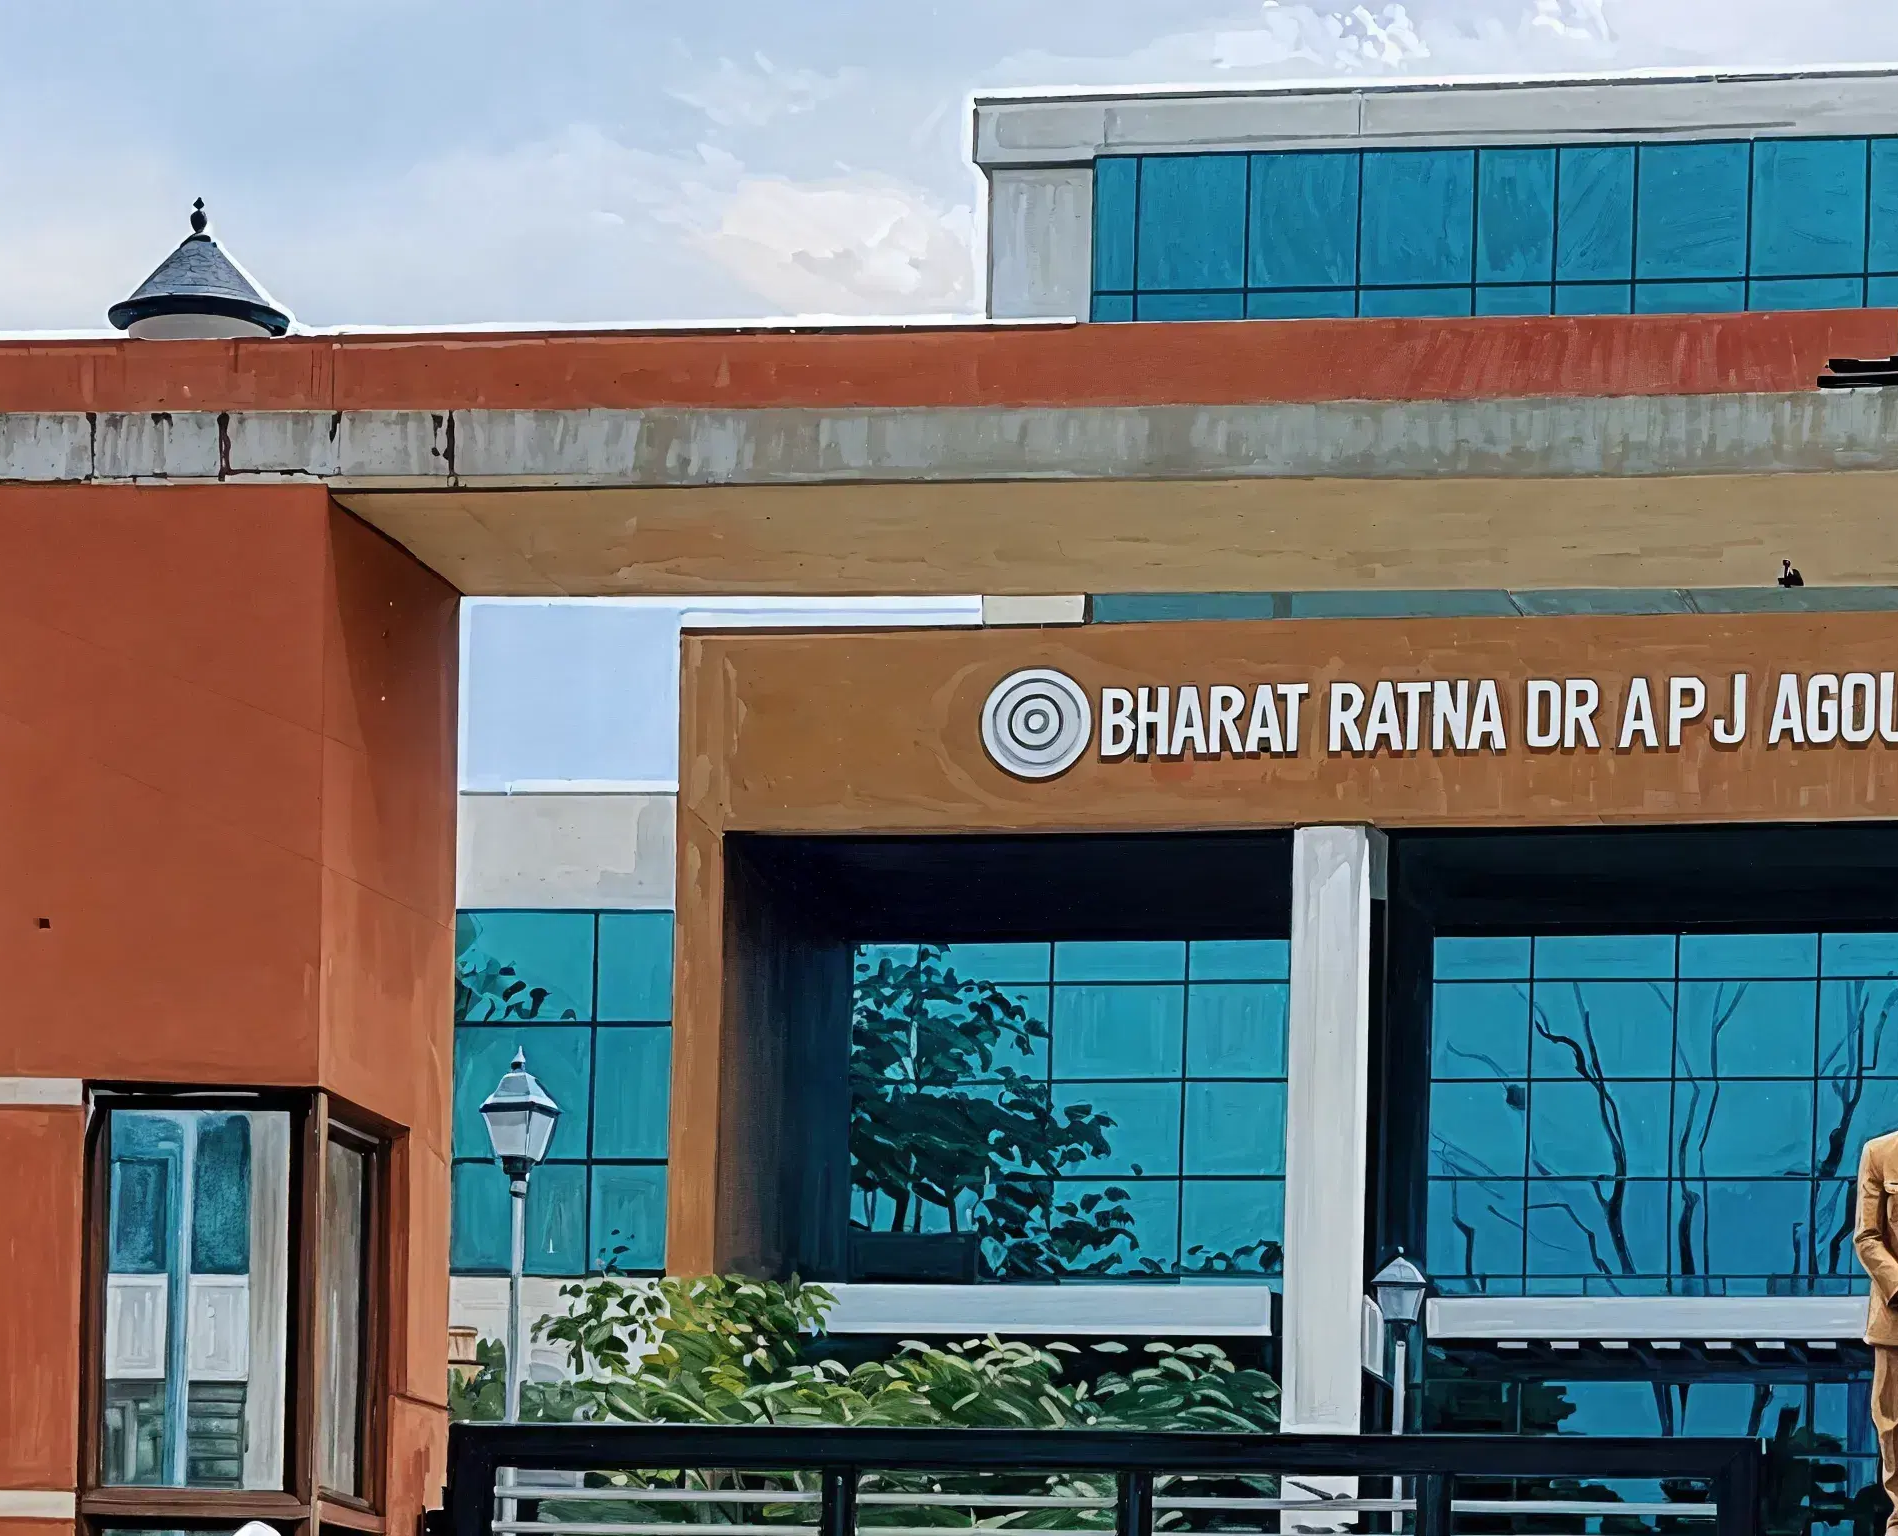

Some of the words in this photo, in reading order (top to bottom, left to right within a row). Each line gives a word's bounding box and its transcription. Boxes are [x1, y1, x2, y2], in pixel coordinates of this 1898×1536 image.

[1100, 682, 1310, 757] BHARAT
[1328, 679, 1507, 755] RATNA
[1526, 678, 1601, 749] DR
